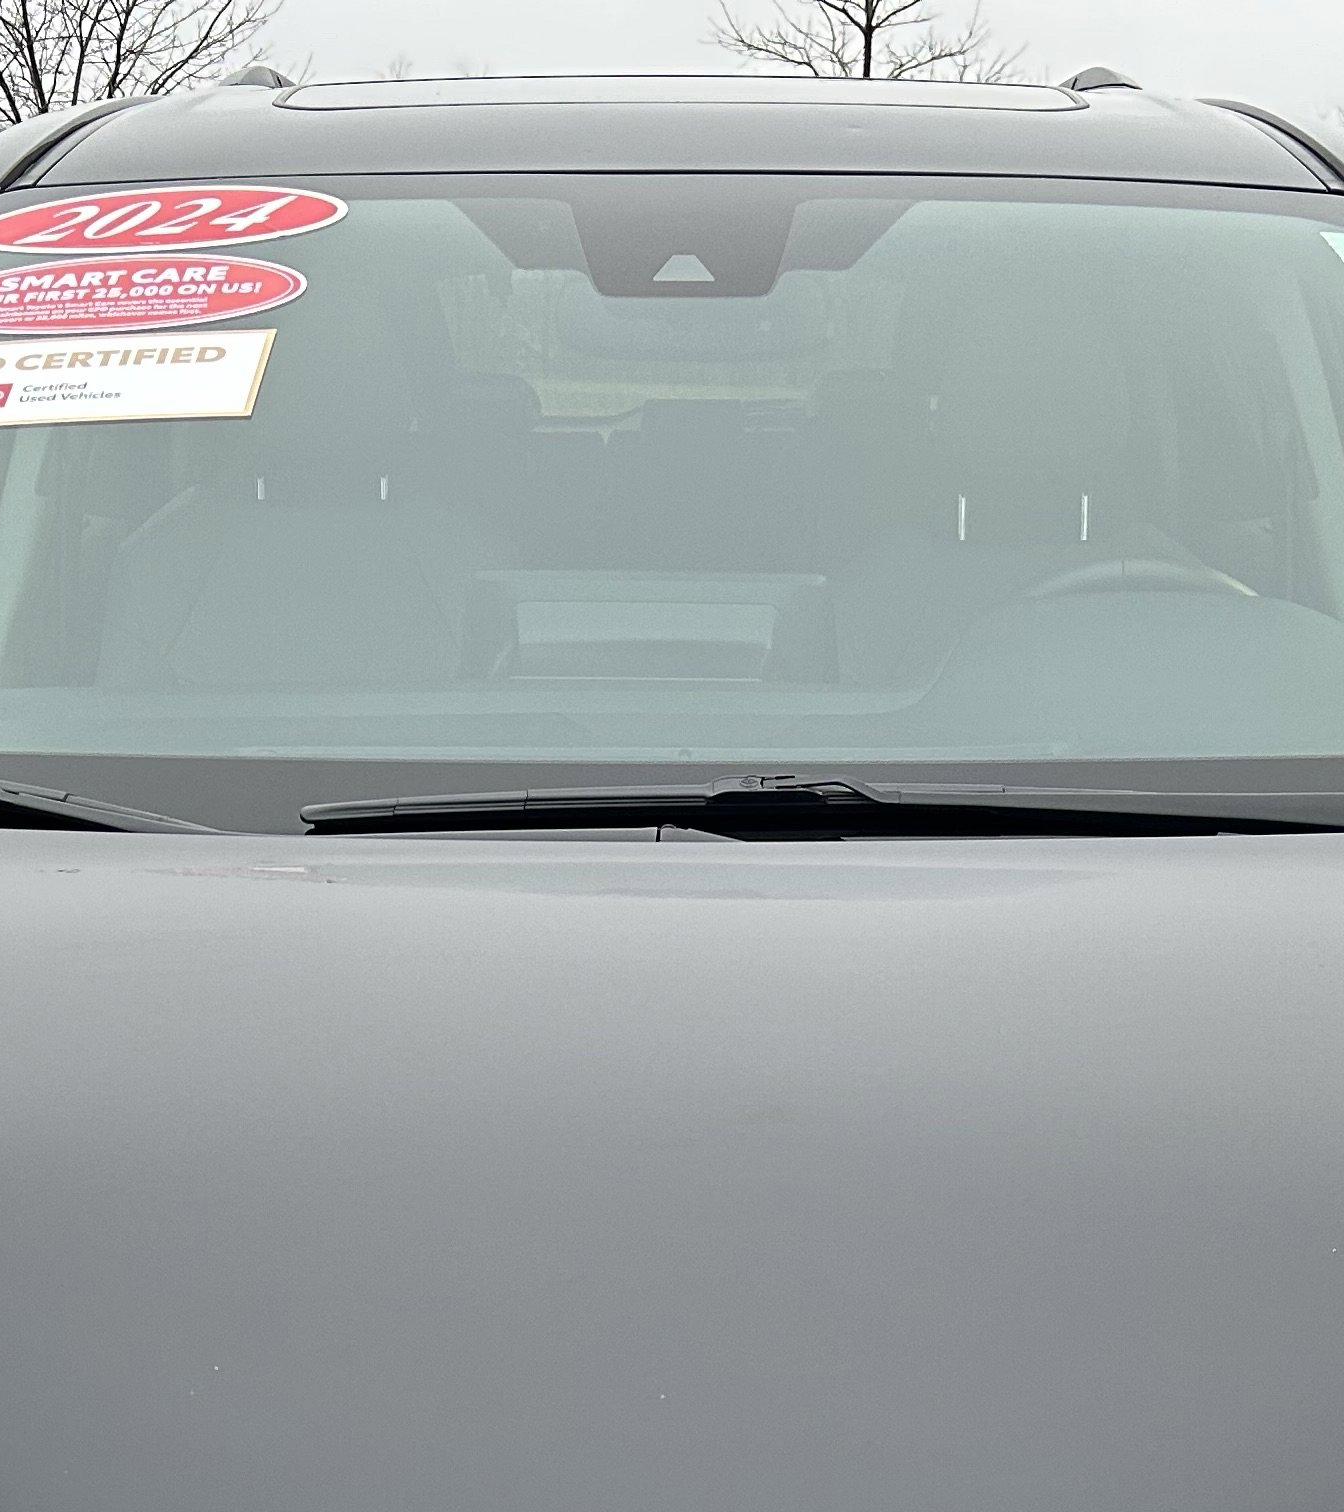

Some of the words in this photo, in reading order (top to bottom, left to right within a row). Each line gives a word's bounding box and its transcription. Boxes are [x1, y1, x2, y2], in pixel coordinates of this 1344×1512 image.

[13, 195, 298, 245] 2024
[131, 265, 229, 284] CARE
[24, 289, 92, 303] FIRST
[92, 285, 171, 299] 25,000
[177, 283, 218, 295] ON
[221, 281, 262, 294] US!
[15, 346, 227, 371] CERTIFIED
[19, 393, 57, 403] Used
[61, 390, 121, 401] Vehicles
[22, 382, 88, 392] Certified
